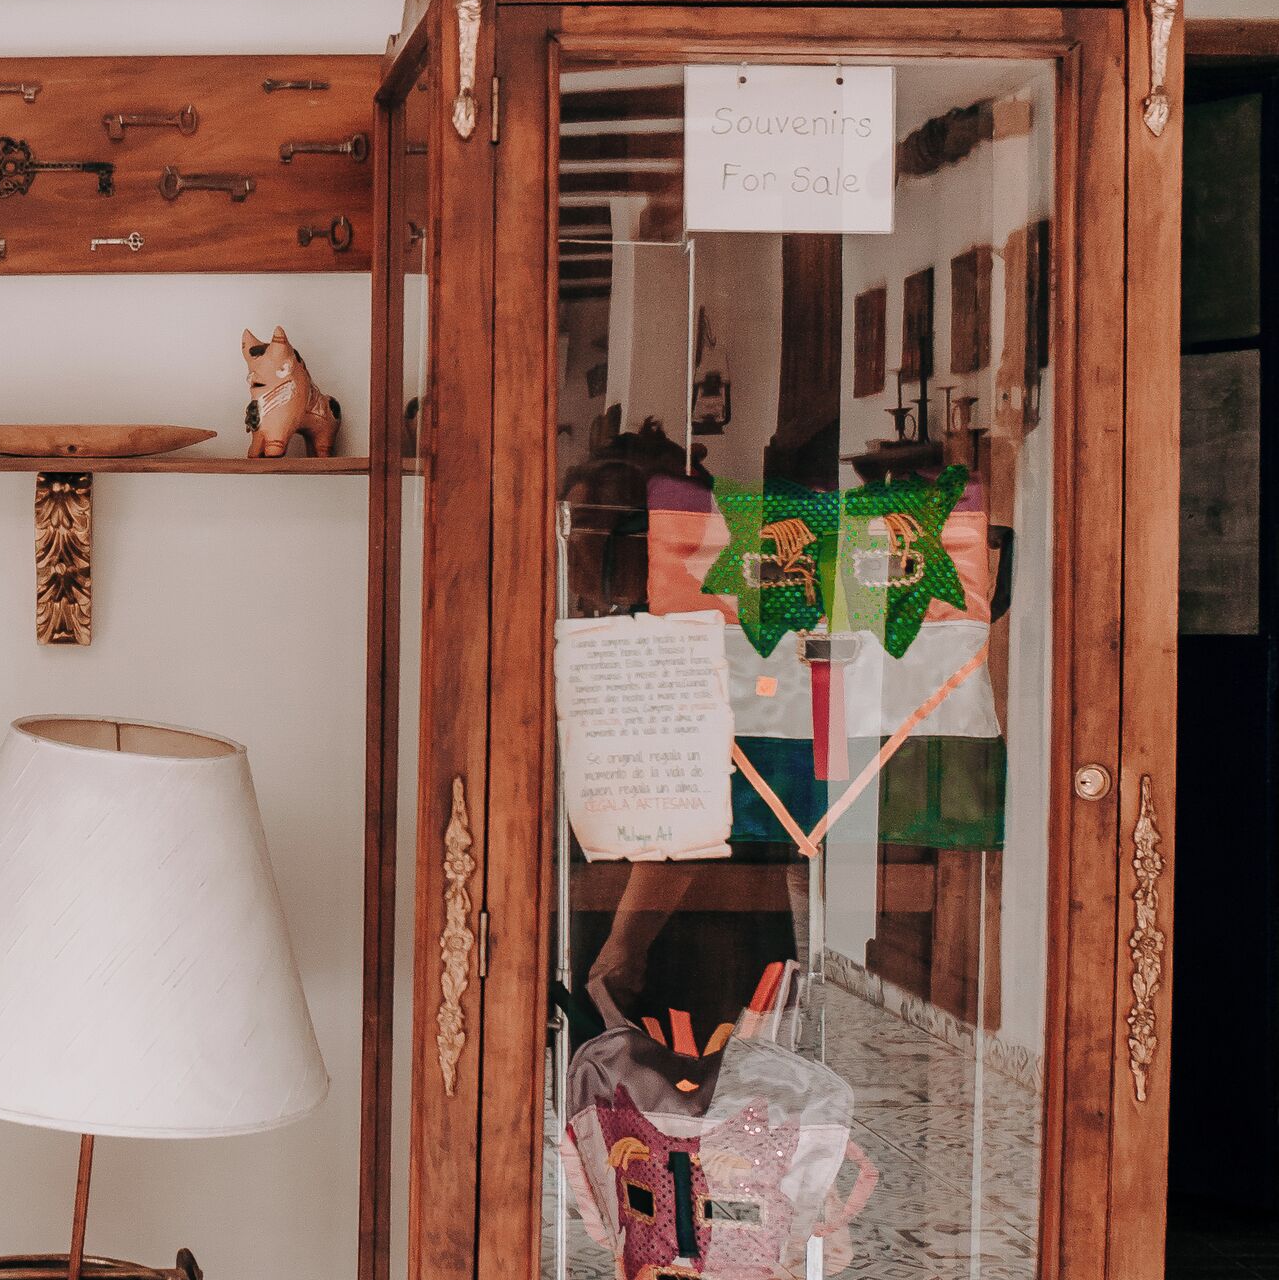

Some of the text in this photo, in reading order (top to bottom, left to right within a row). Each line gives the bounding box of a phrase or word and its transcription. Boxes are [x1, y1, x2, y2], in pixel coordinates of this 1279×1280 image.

[712, 107, 872, 138] Souvenirs
[721, 163, 861, 195] For Sale
